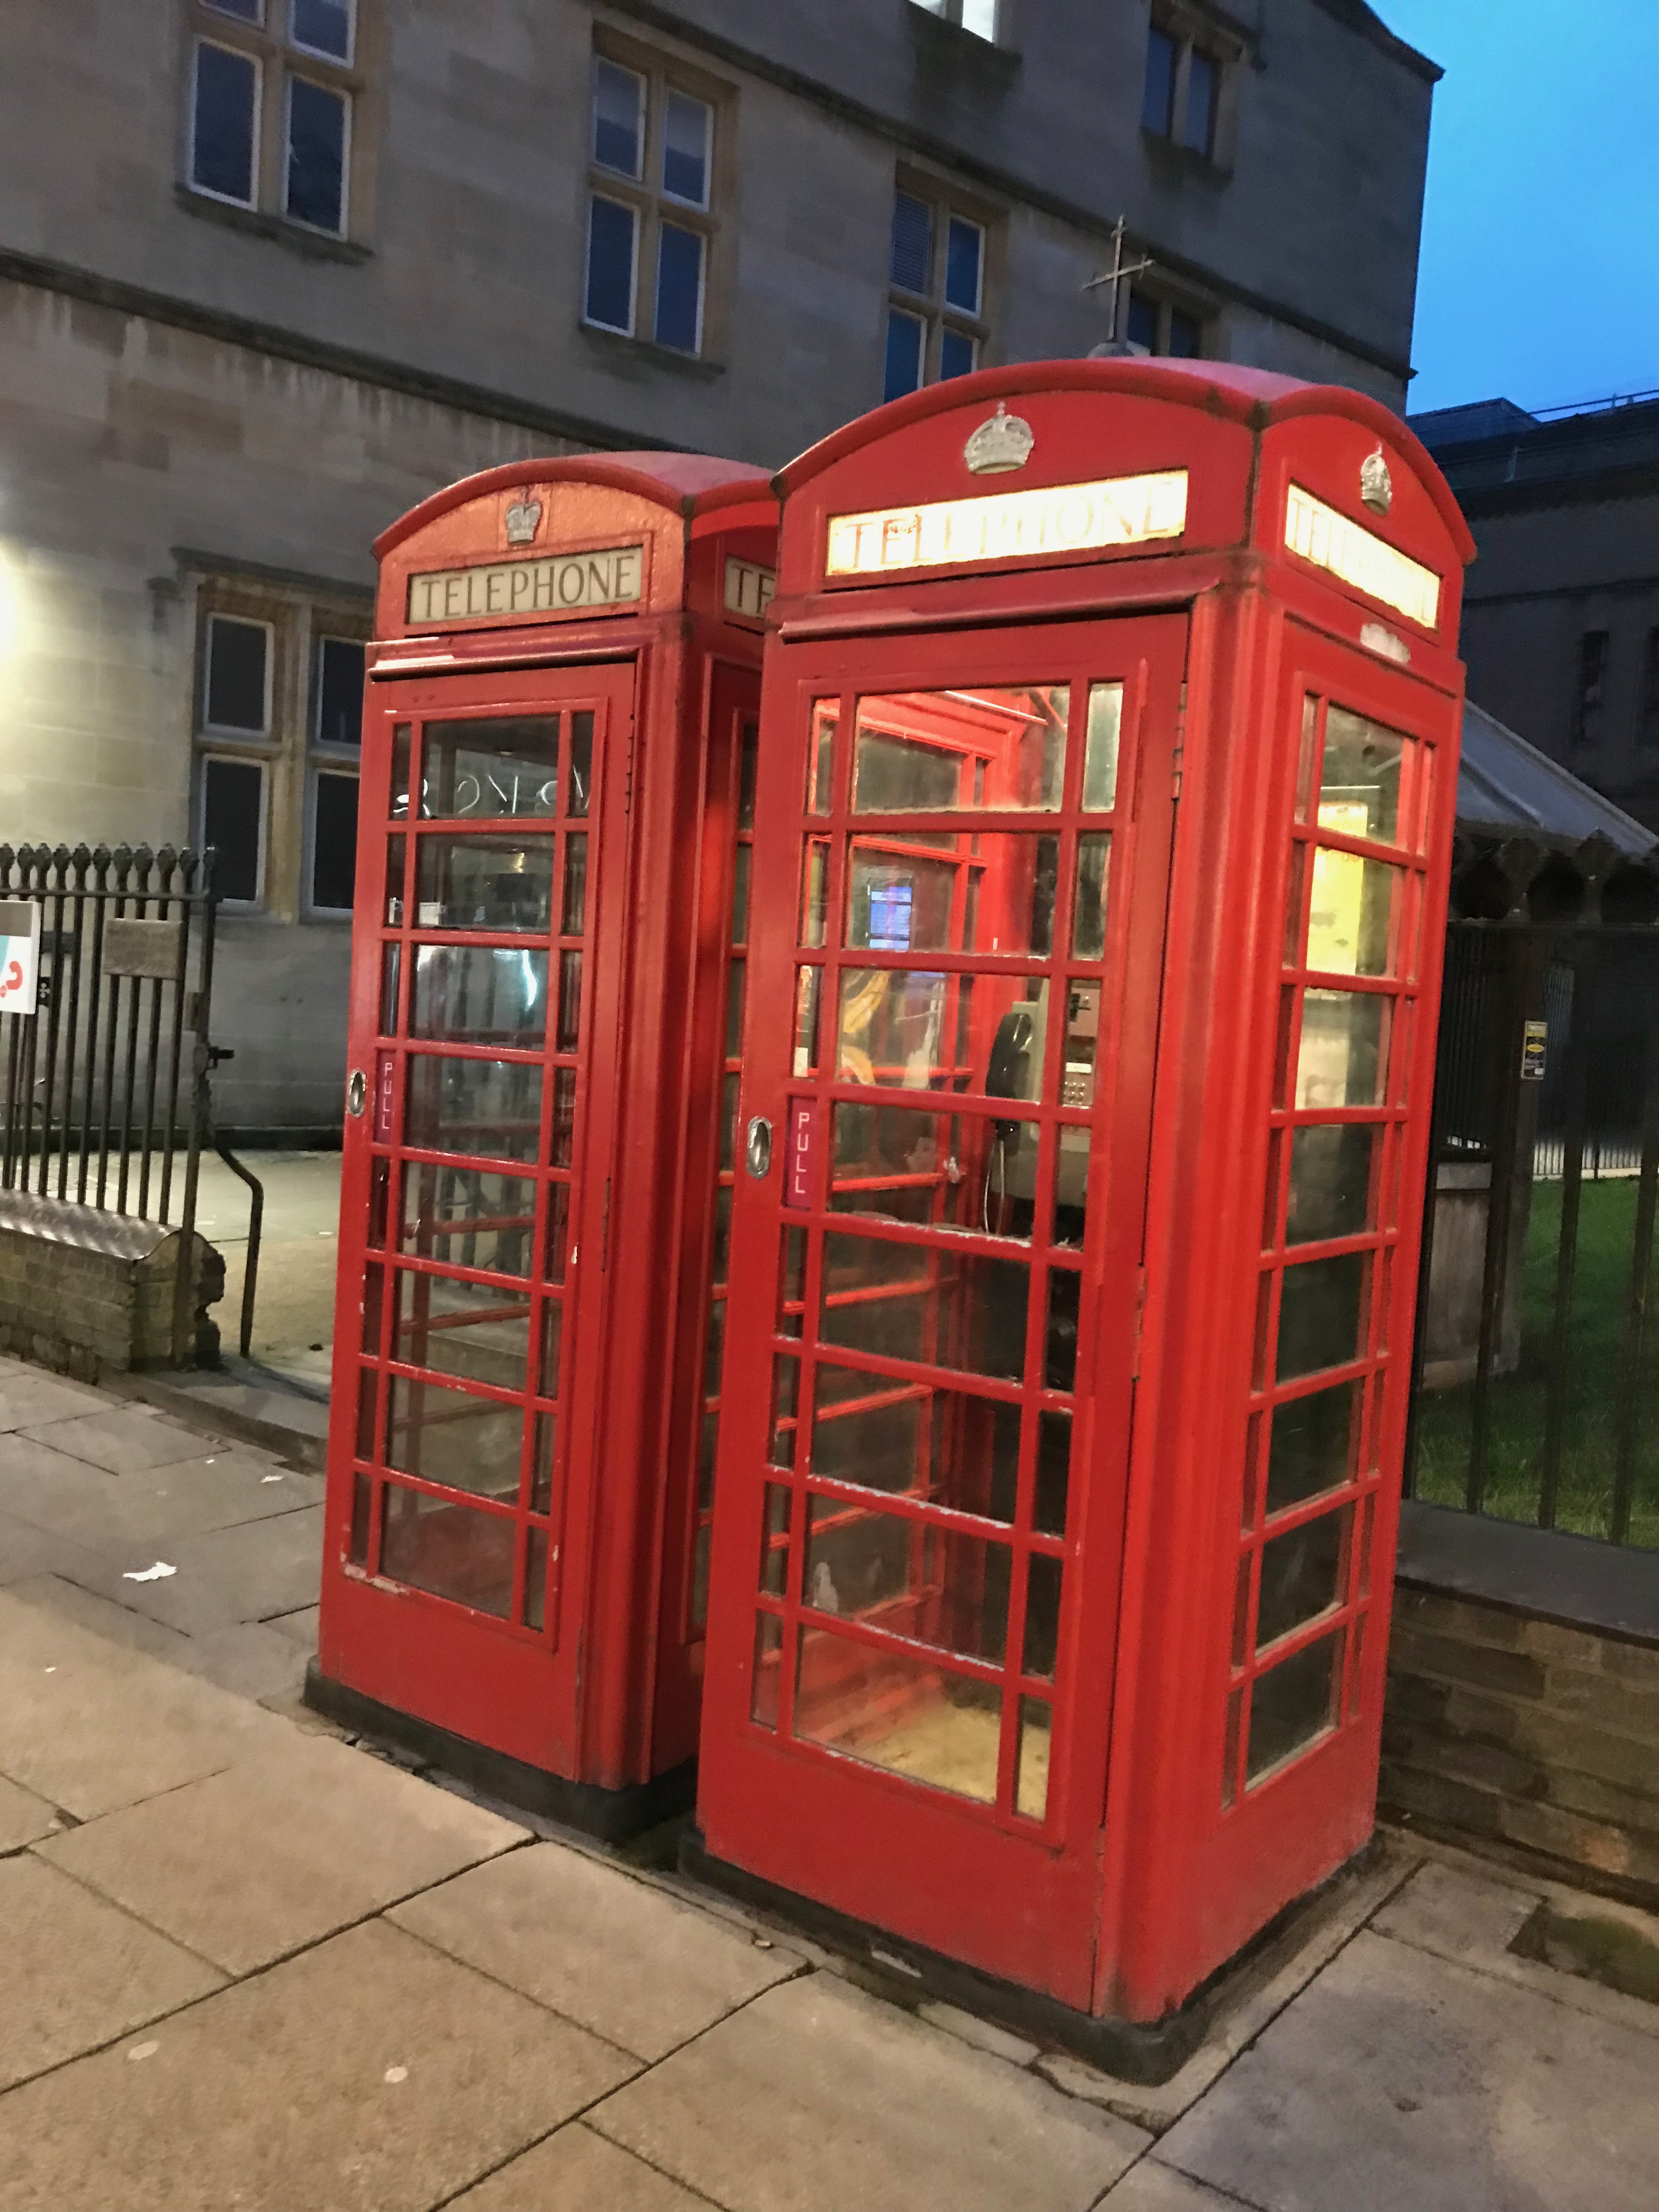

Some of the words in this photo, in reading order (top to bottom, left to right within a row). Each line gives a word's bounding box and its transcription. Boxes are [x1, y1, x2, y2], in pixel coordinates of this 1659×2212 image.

[845, 481, 1172, 568] TELEPHONE
[421, 555, 635, 618] TELEPHONE
[381, 1062, 393, 1130] PULL
[795, 1112, 810, 1194] PULL
